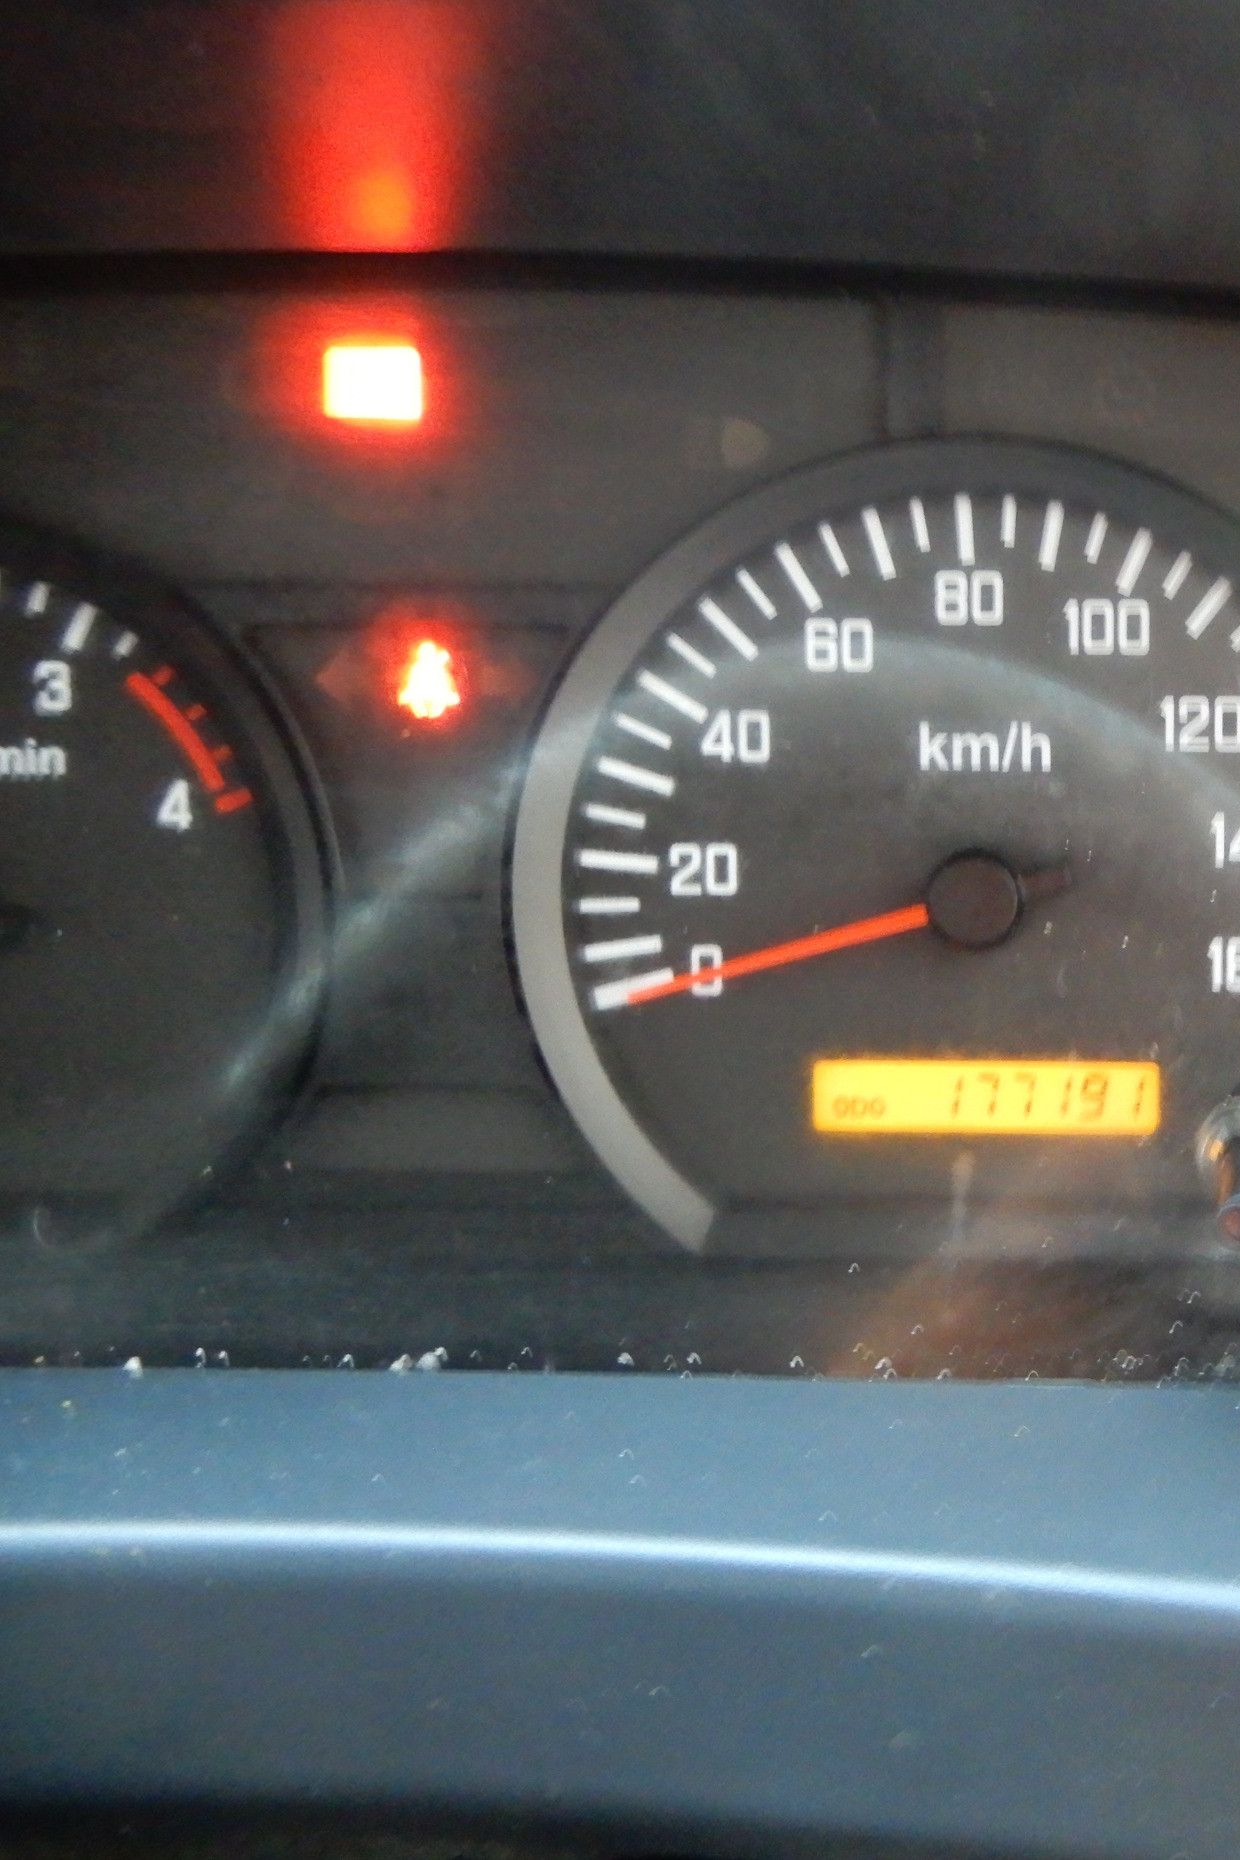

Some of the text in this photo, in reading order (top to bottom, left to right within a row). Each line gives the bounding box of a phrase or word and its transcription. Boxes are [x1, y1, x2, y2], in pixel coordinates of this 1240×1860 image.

[934, 569, 1004, 627] 80
[804, 617, 874, 673] 60
[1062, 597, 1150, 656] 100
[33, 659, 73, 715] 3
[701, 709, 771, 763] 40
[919, 720, 1051, 773] km/h
[157, 777, 193, 832] 4
[668, 841, 739, 897] 20
[690, 942, 724, 998] 0
[951, 1073, 1146, 1121] 177191
